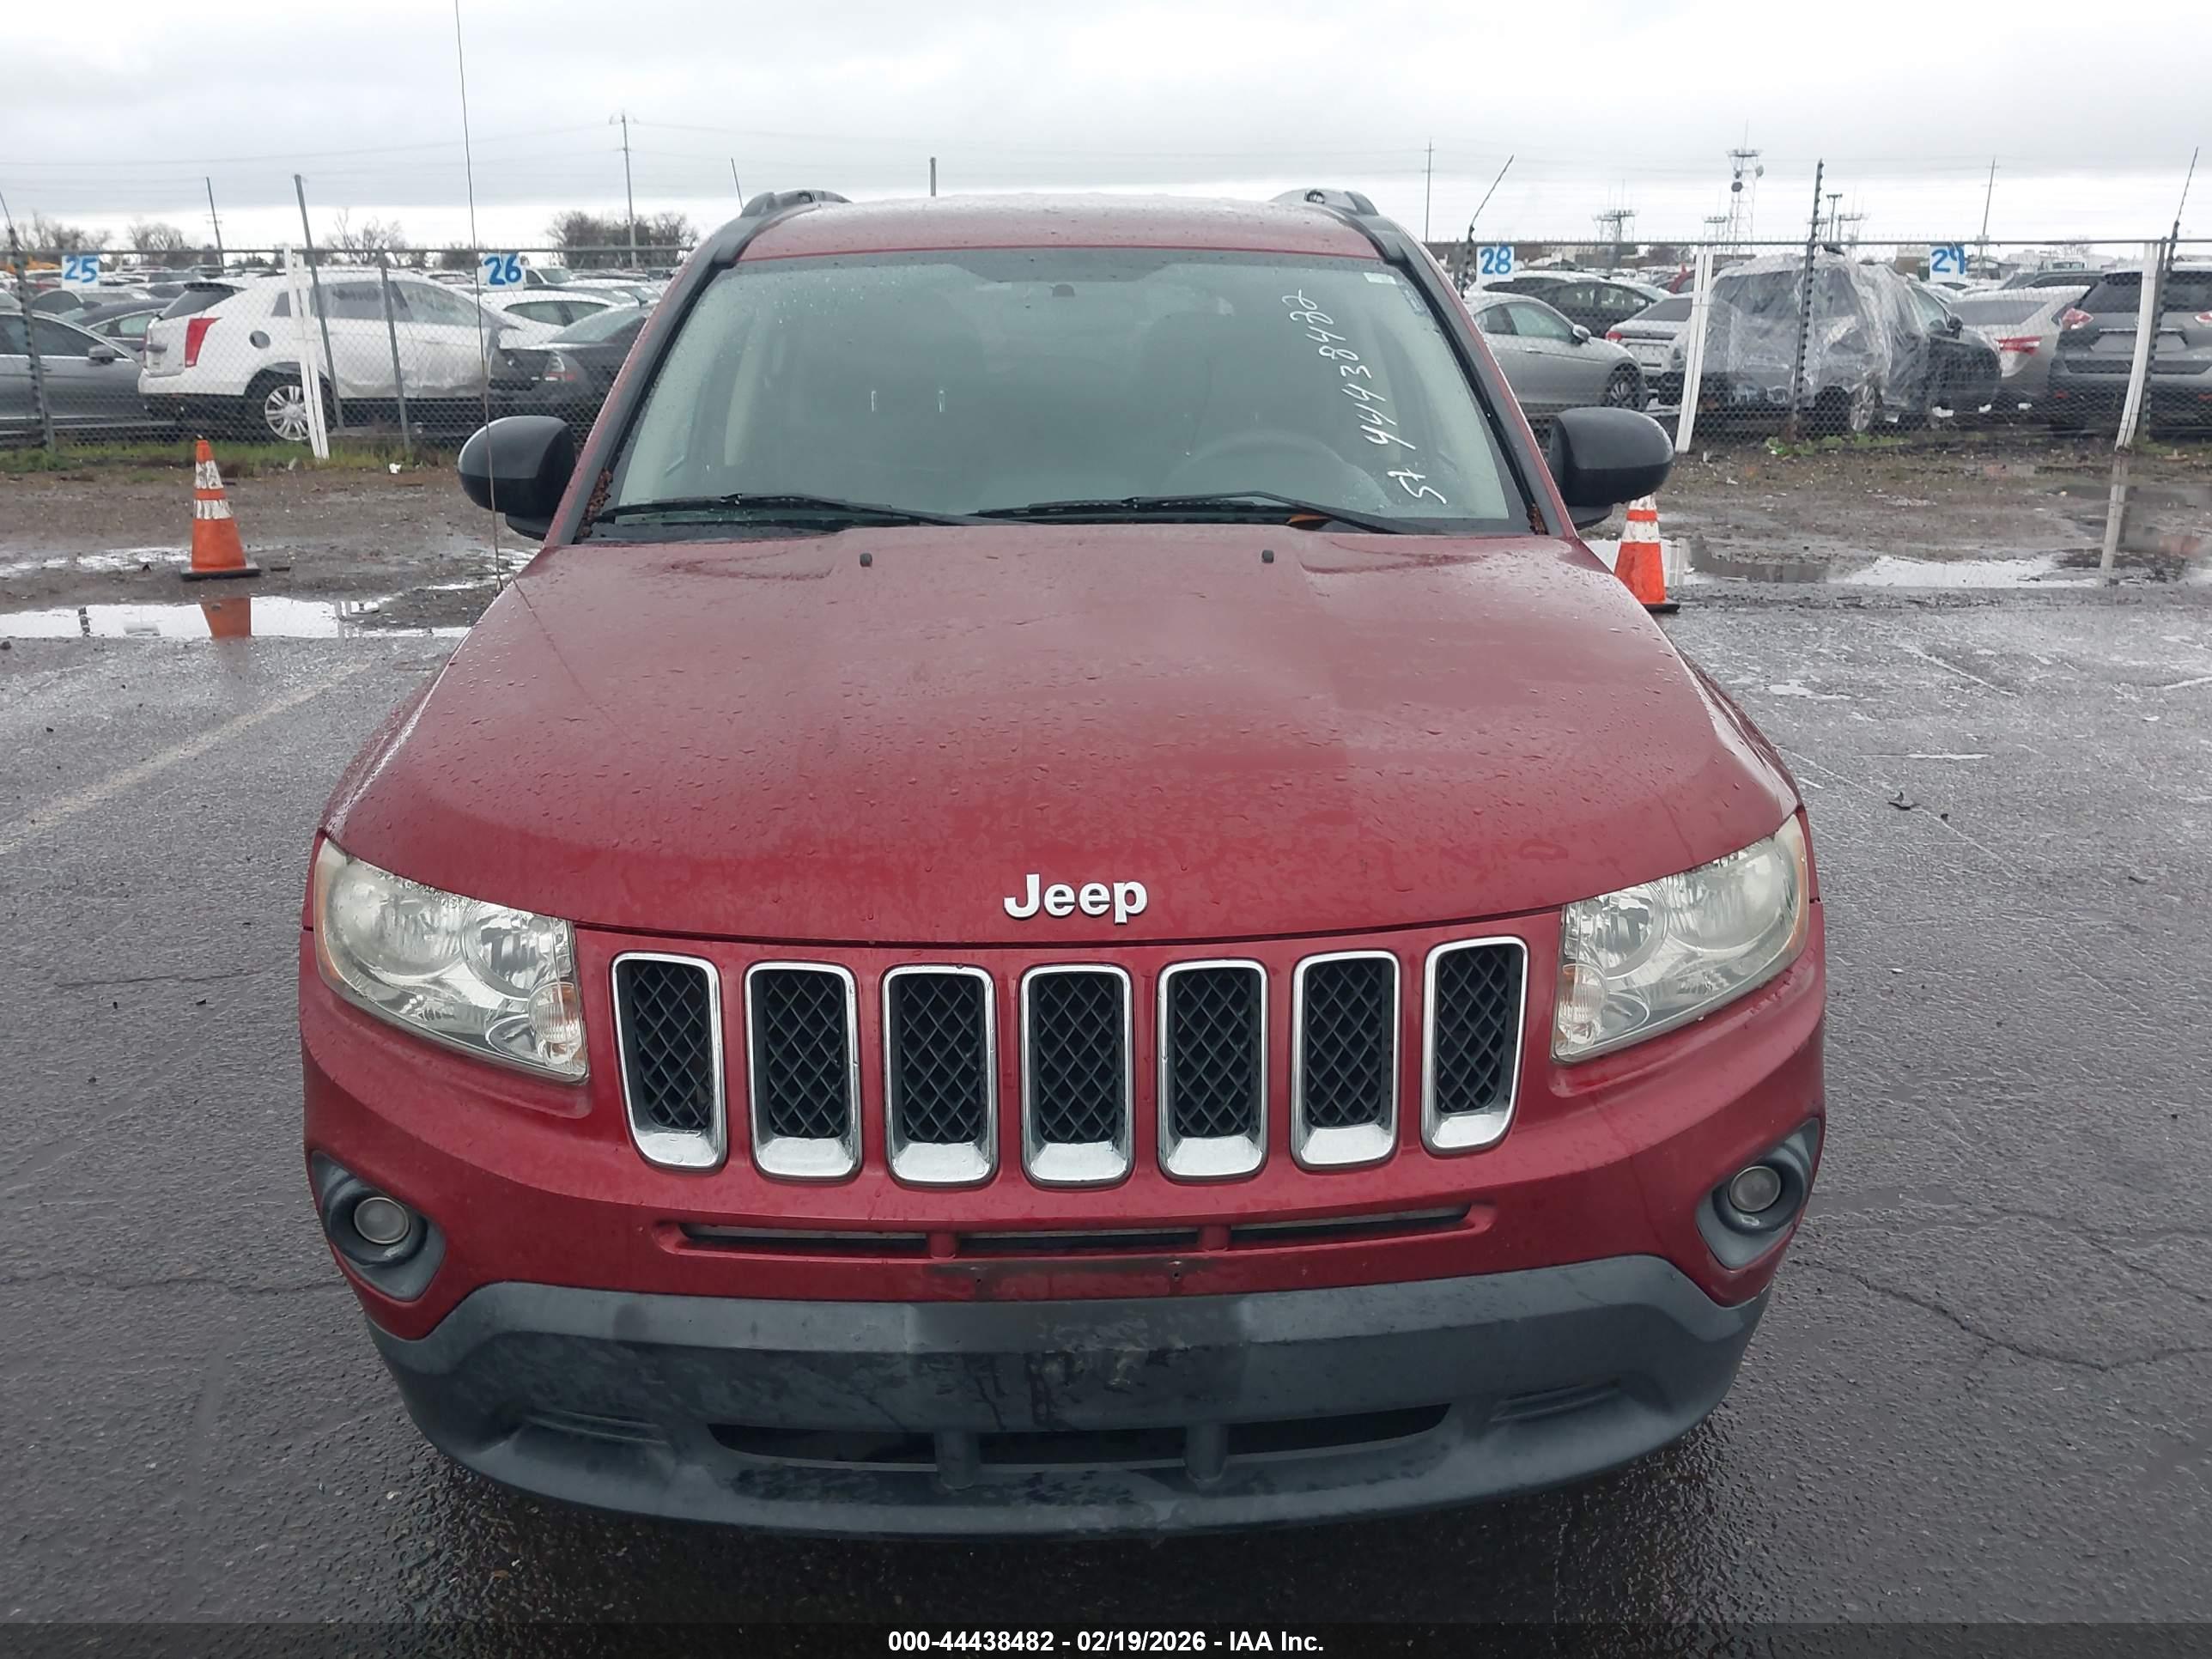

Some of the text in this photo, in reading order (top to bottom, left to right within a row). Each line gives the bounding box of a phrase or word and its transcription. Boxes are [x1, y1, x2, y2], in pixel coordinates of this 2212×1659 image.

[64, 254, 97, 283] 25
[483, 252, 522, 285] 26
[1480, 244, 1511, 275] 28
[1003, 872, 1148, 924] Jeep
